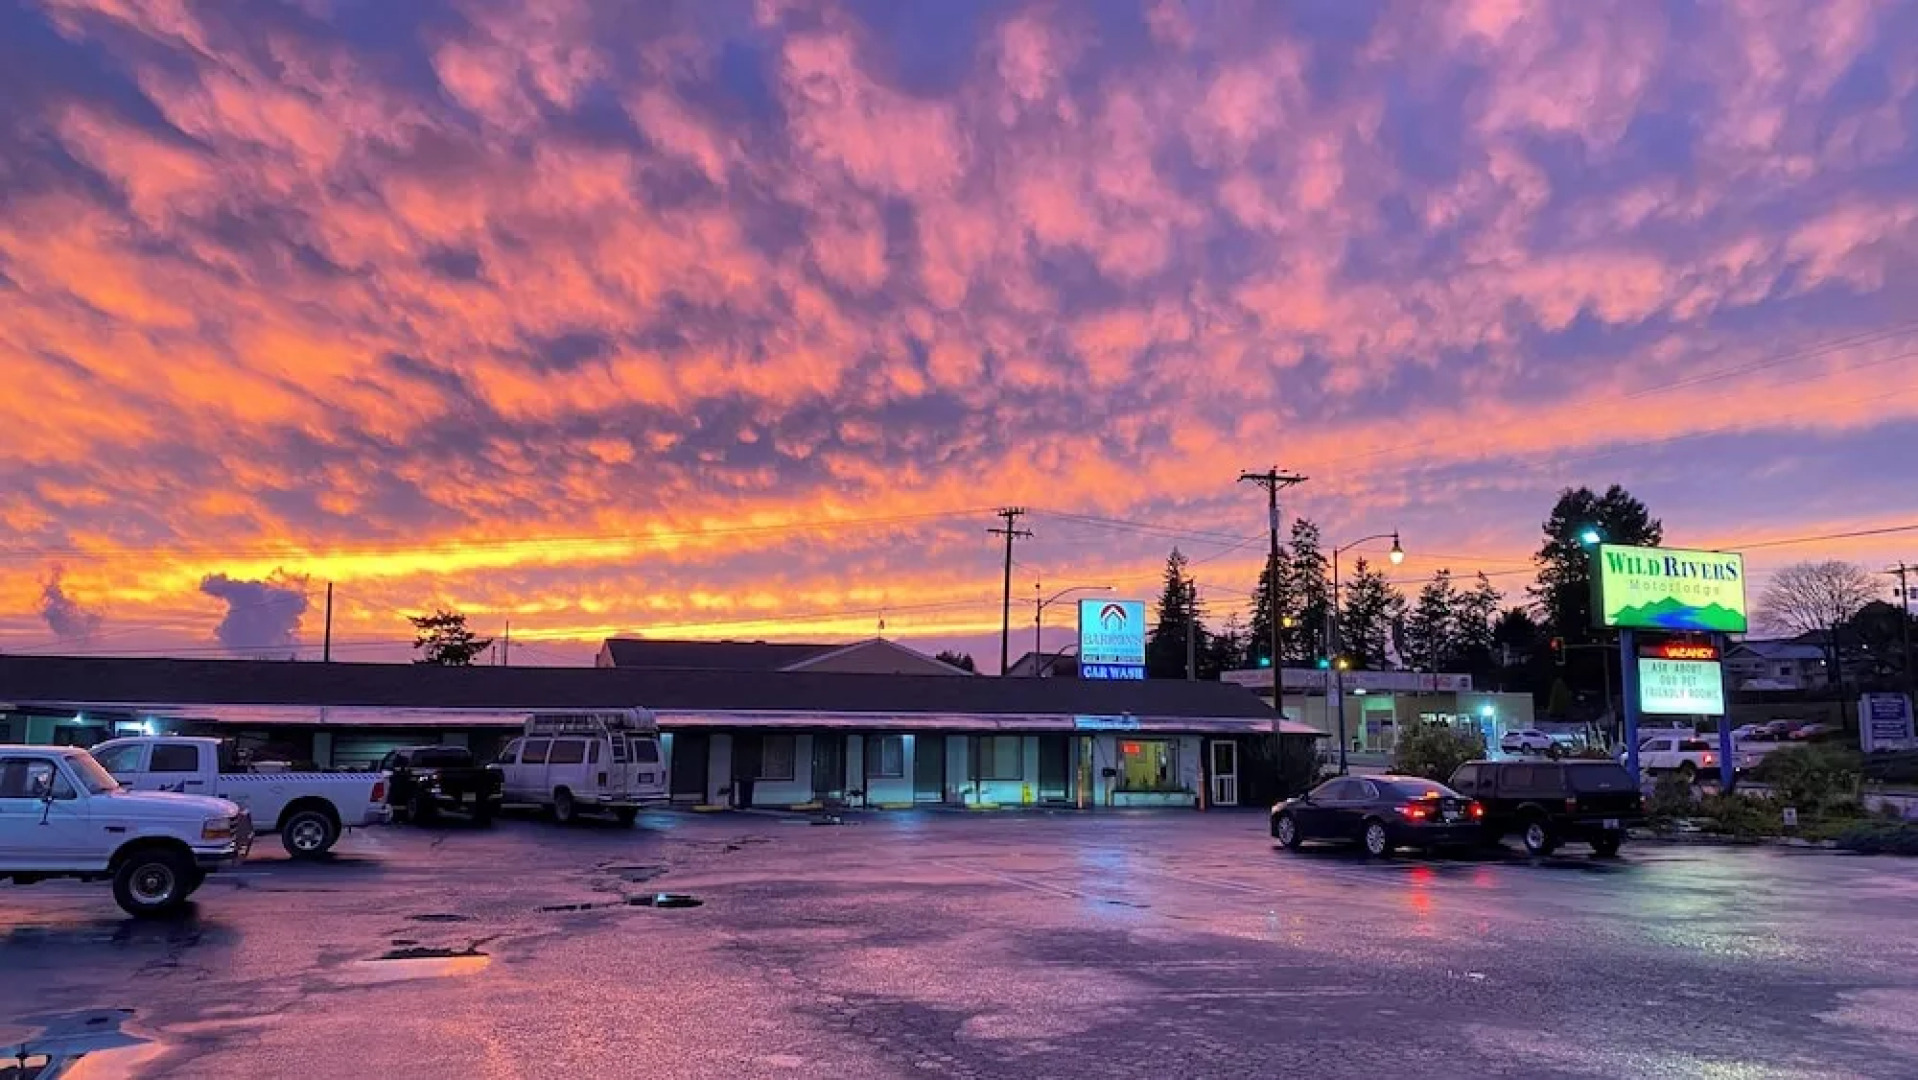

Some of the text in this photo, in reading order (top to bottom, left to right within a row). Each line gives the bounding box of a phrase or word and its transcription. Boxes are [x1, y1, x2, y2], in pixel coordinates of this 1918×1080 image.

[1630, 580, 1720, 596] Motorlodge
[1665, 647, 1714, 658] VACANCY
[1083, 666, 1144, 680] CAR WASH
[1652, 662, 1702, 673] ASK ABOUT
